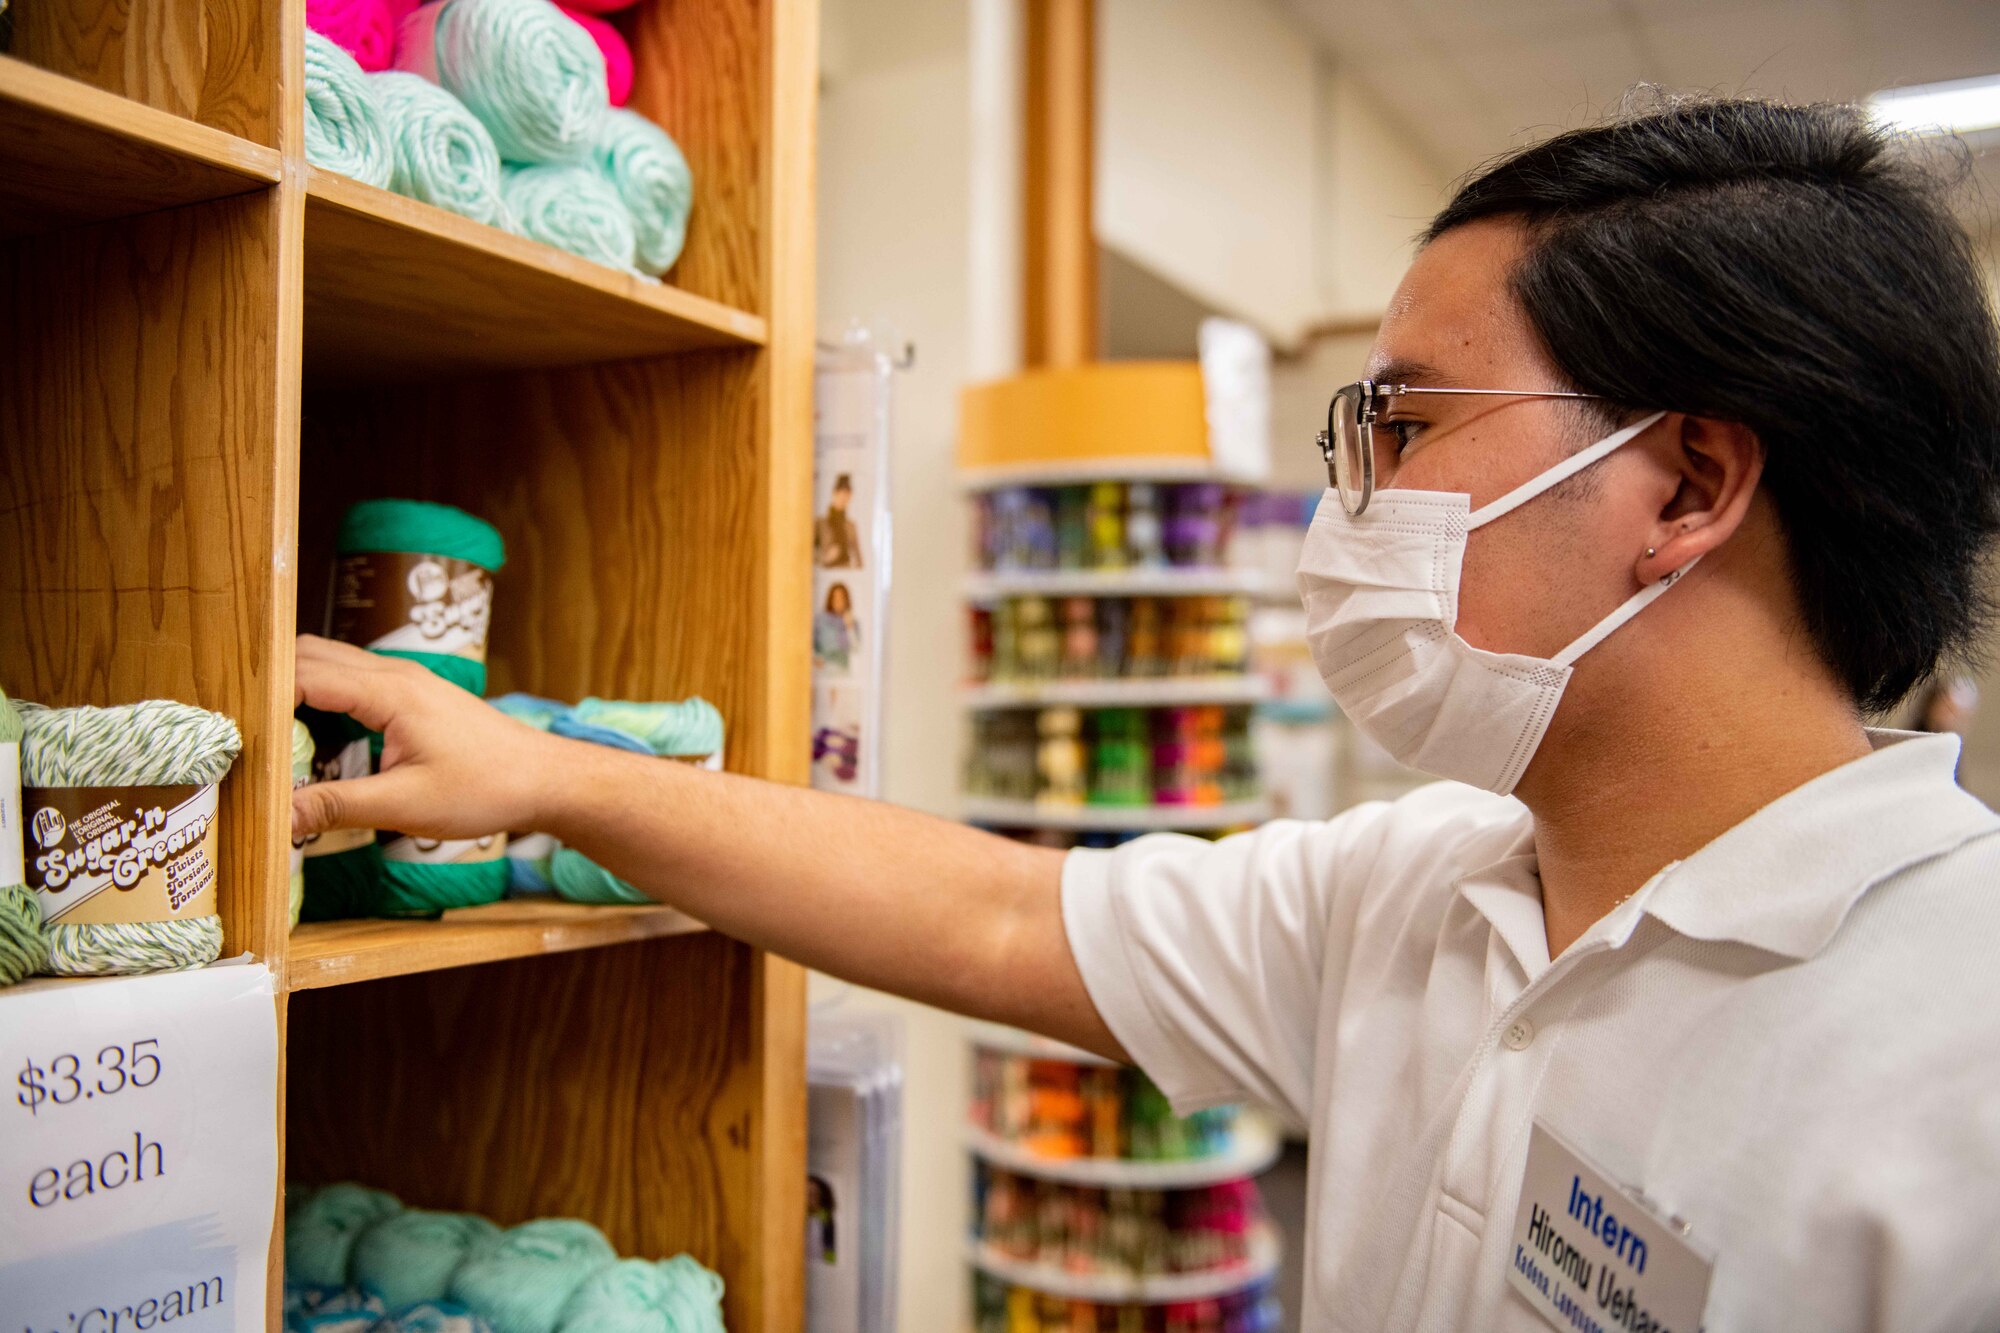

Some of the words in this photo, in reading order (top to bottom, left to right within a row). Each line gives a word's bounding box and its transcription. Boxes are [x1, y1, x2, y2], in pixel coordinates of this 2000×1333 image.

[69, 819, 83, 831] THE
[82, 799, 121, 823] ORIGINAL
[73, 812, 115, 839] L'ORIGINAL
[77, 836, 87, 845] EL
[87, 816, 124, 840] ORIGINAL
[99, 814, 208, 888] Cream
[166, 849, 204, 879] Twists
[166, 858, 210, 895] Torsions
[170, 868, 215, 910] Torsiones
[17, 1038, 161, 1116] $3.35
[29, 1132, 165, 1208] each
[1568, 1175, 1648, 1275] Intern
[1528, 1203, 1593, 1292] Hiromu
[1598, 1265, 1670, 1333] Uehar
[25, 1277, 223, 1333] 'Cream
